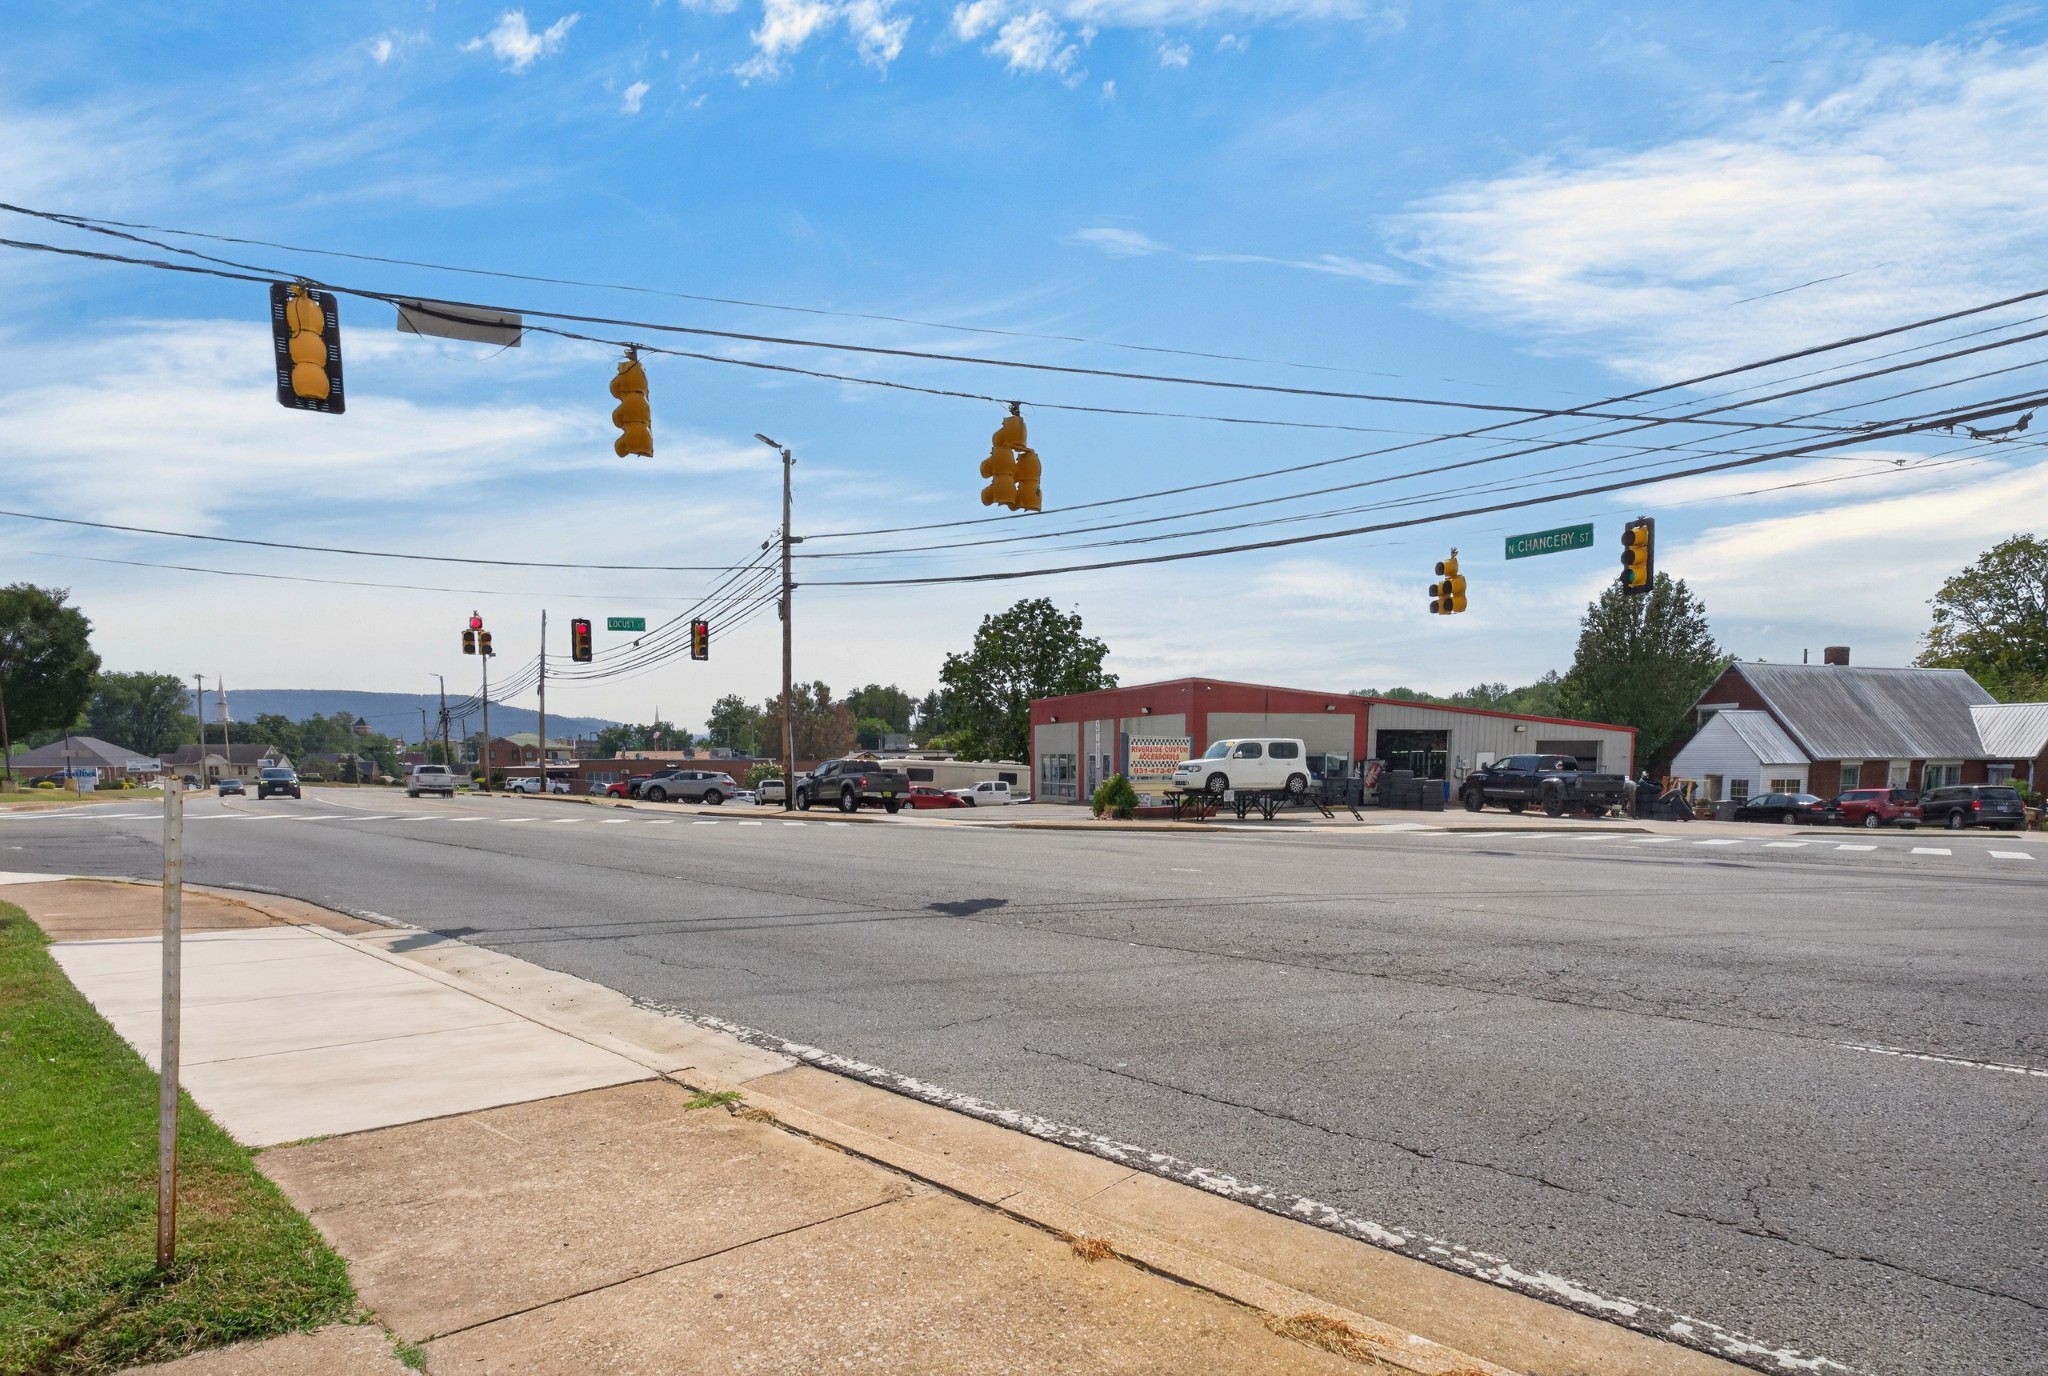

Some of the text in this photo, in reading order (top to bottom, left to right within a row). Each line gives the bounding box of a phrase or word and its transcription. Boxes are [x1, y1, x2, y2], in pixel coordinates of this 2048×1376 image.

[1508, 532, 1590, 555] N CHANCERY ST
[608, 620, 634, 629] LOCUST
[1131, 745, 1163, 753] RIVERSIDE
